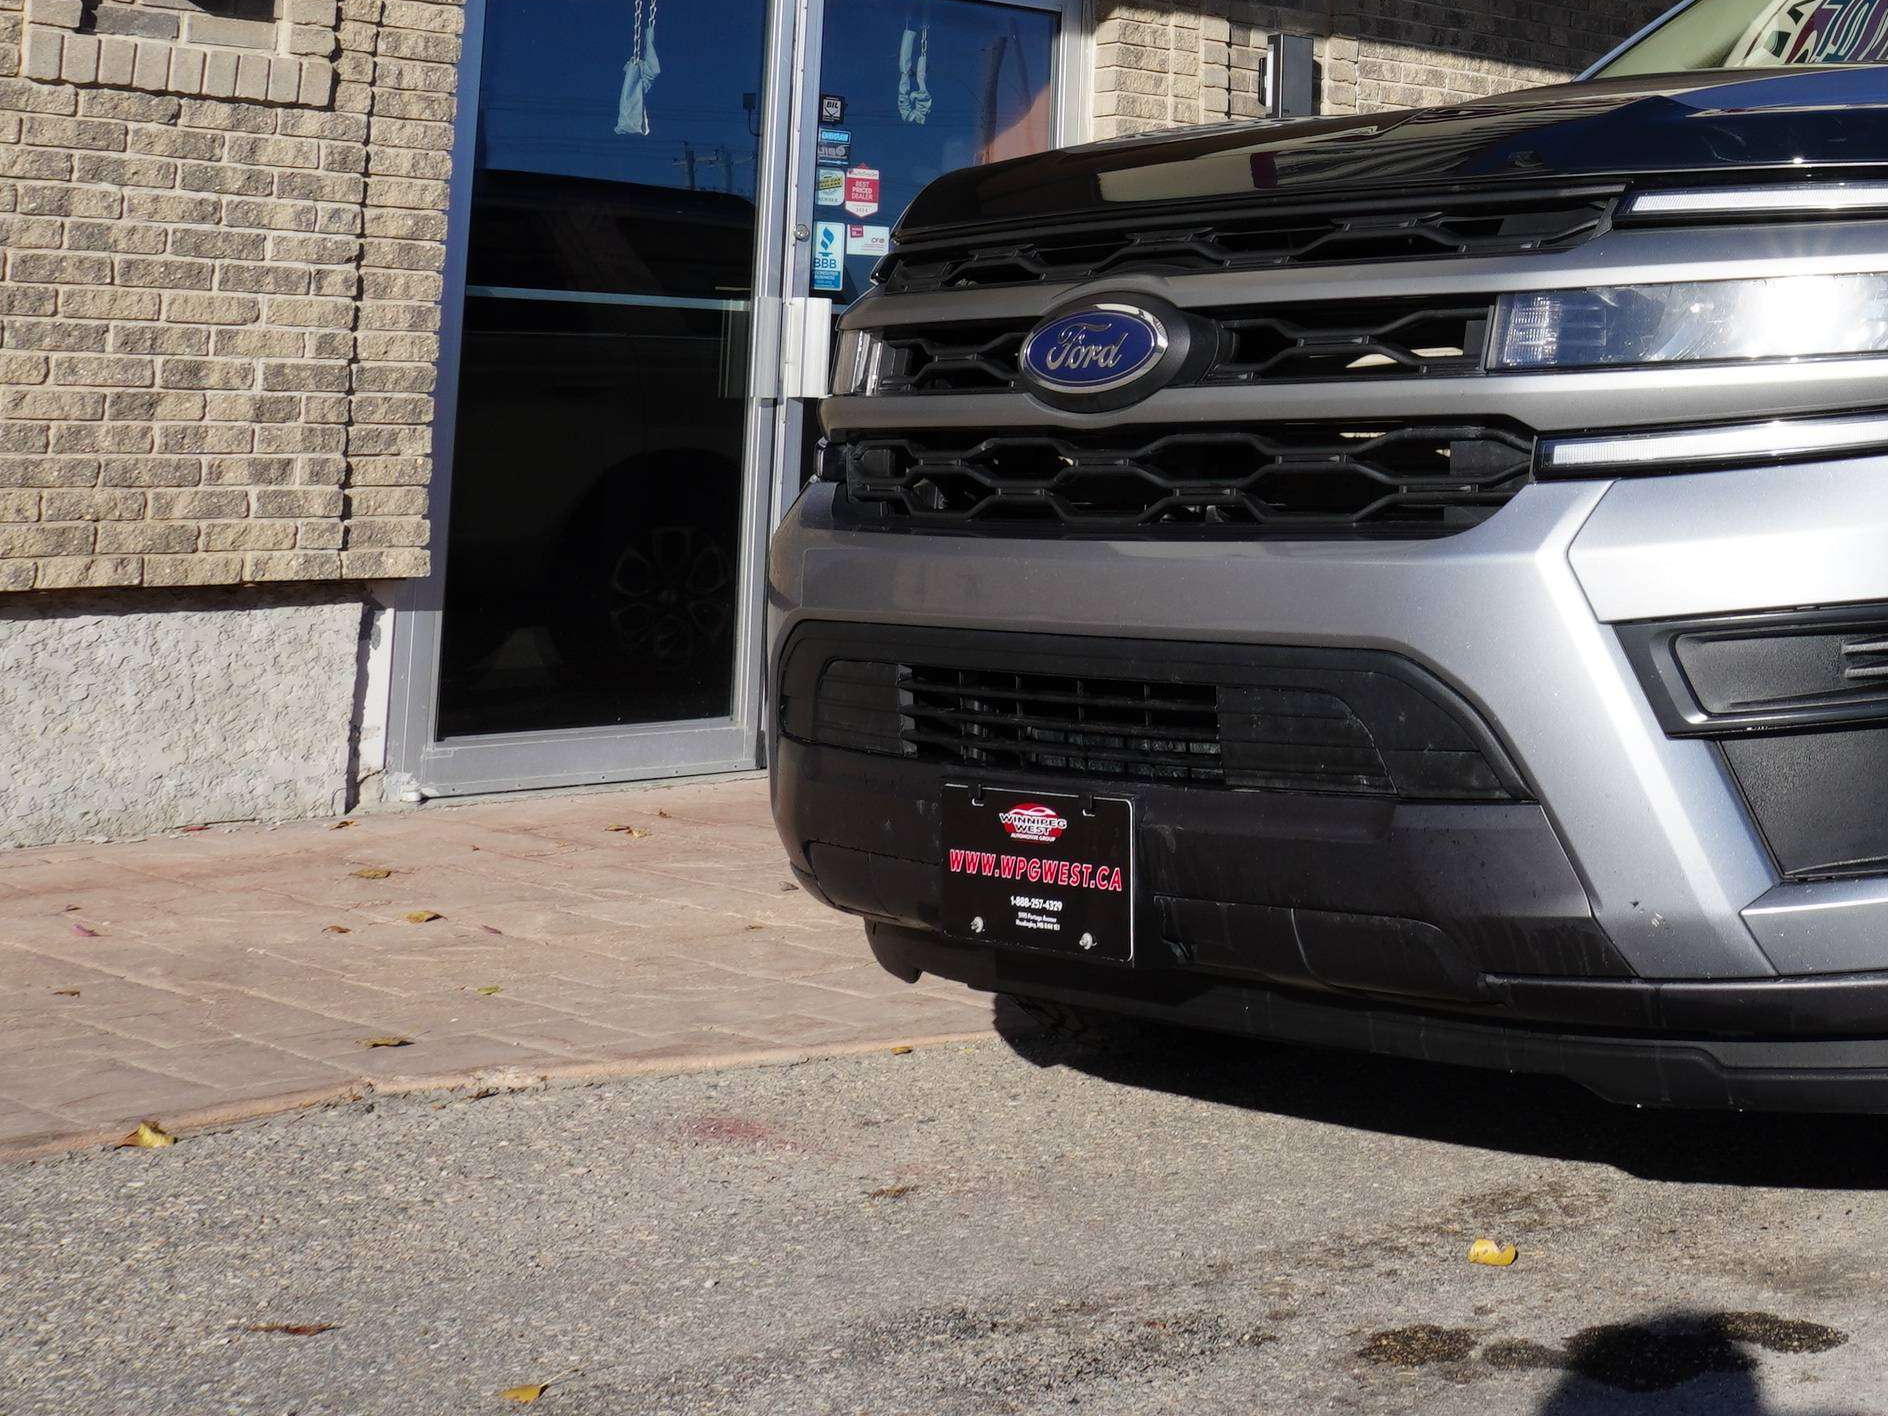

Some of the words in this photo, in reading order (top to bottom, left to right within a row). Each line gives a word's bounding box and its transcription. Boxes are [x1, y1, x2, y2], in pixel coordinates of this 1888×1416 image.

[1046, 322, 1129, 370] Ford
[999, 813, 1067, 829] WINNIPEG
[1014, 824, 1051, 835] WEST
[950, 849, 1123, 891] WWW.WPGWEST.CA
